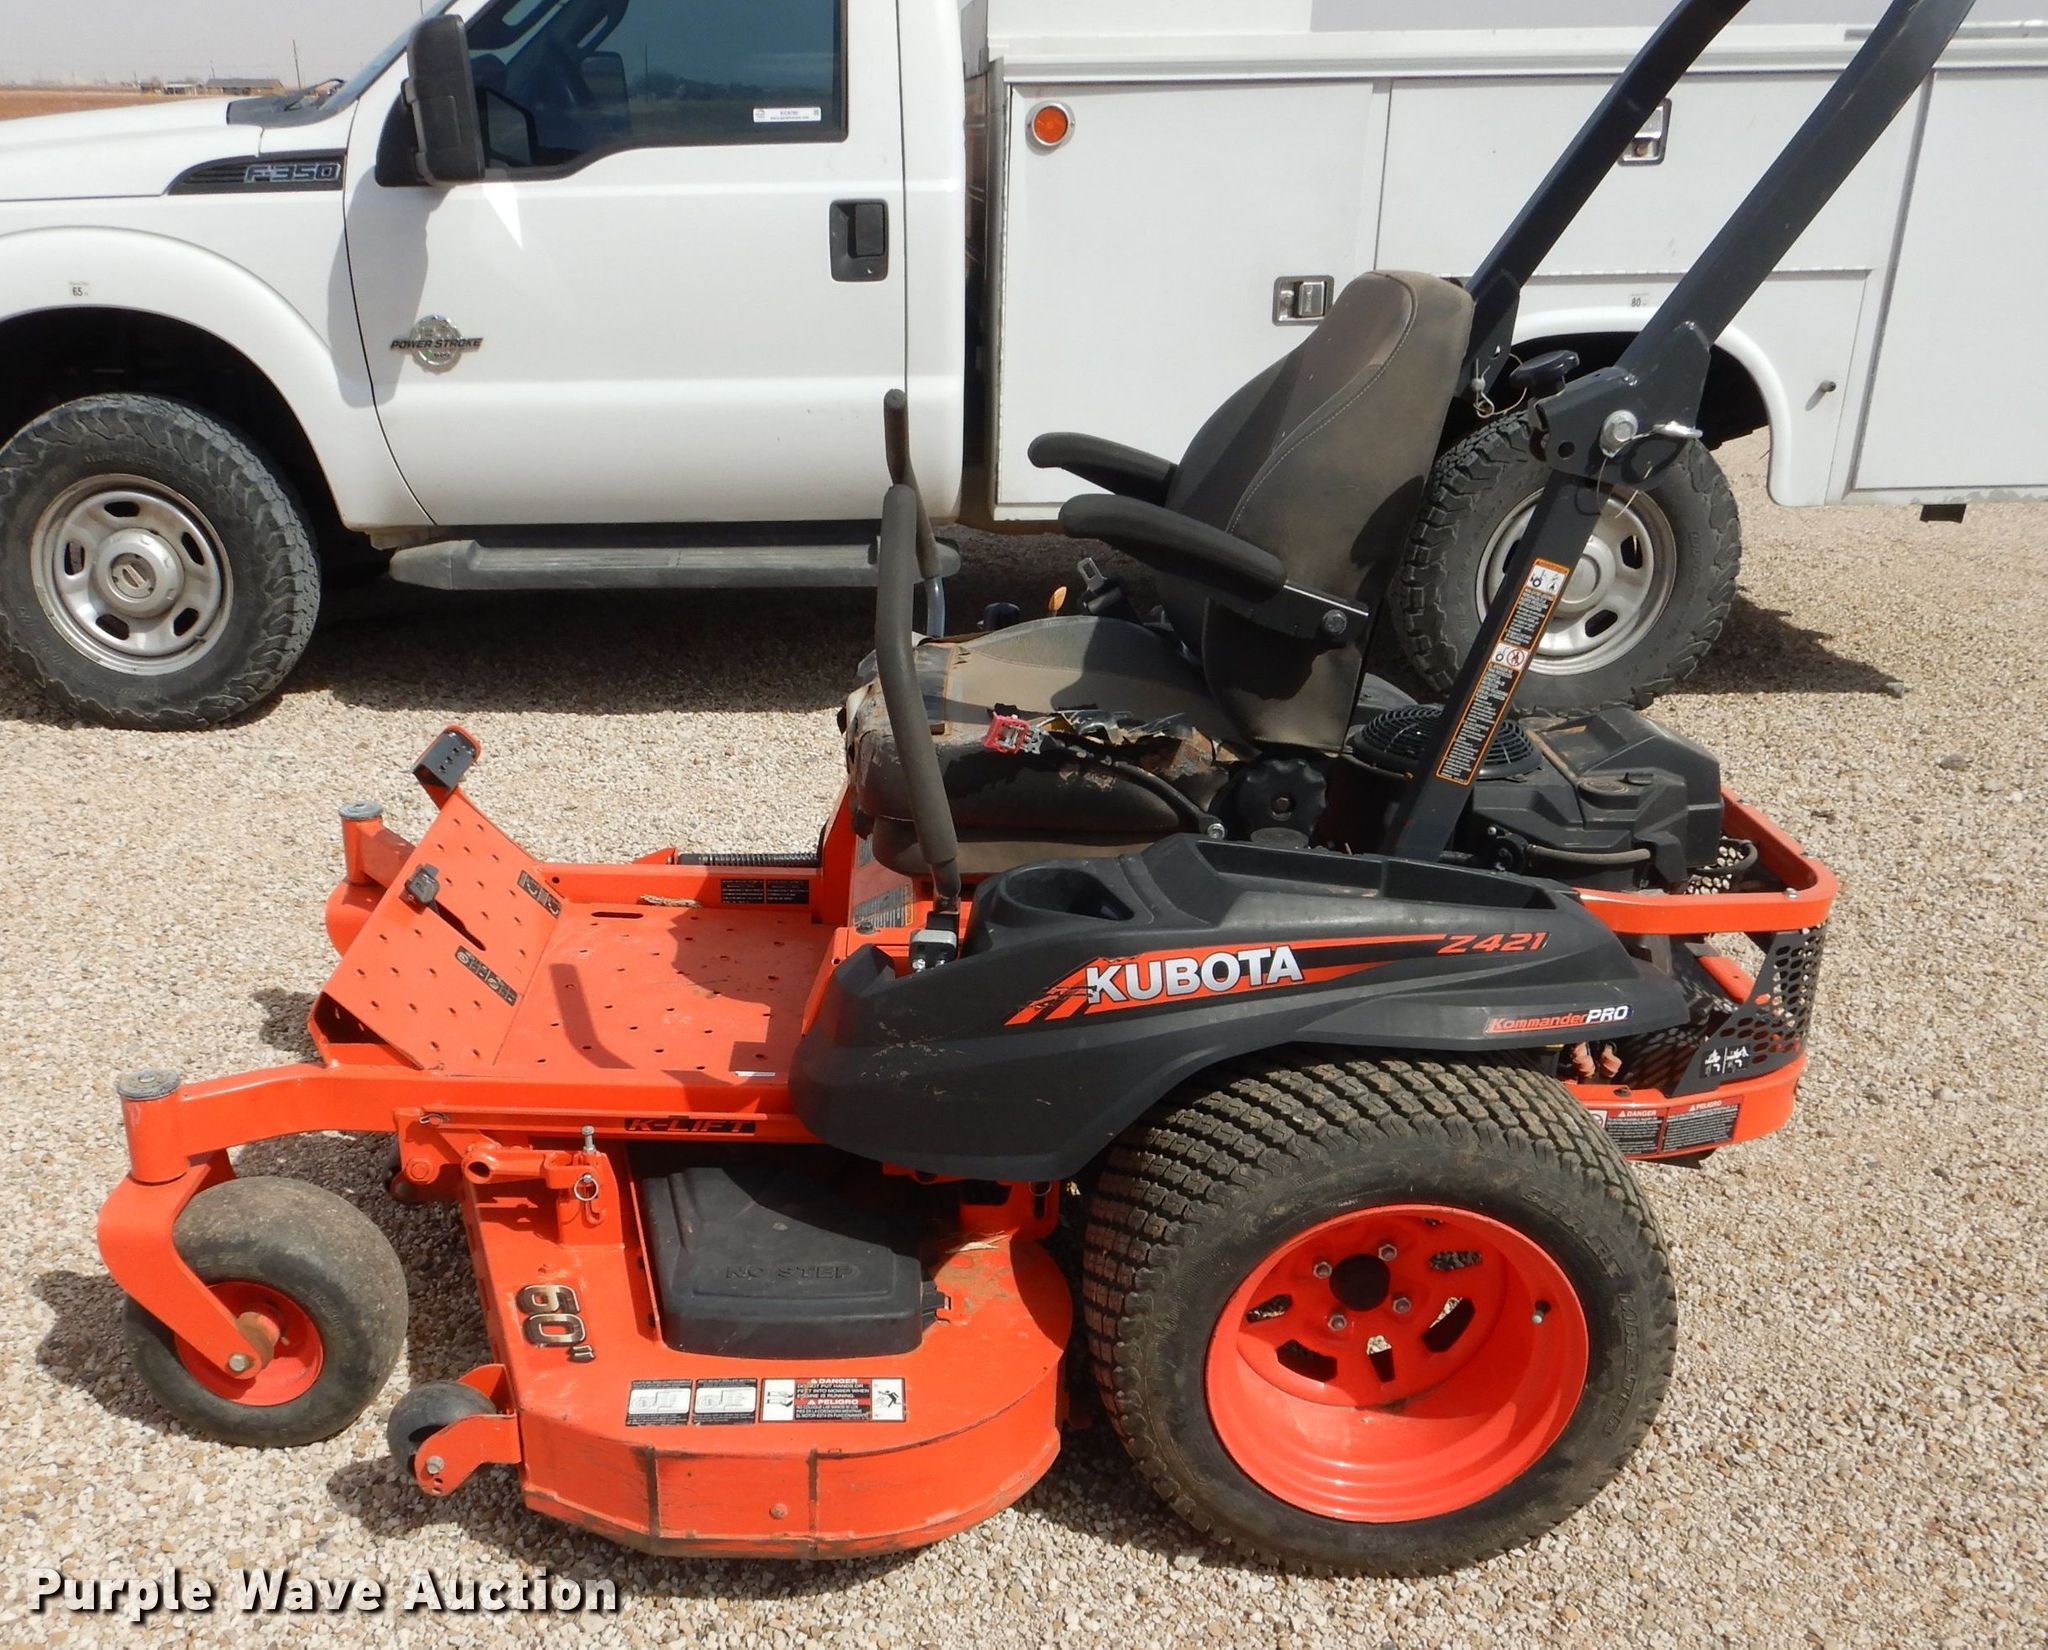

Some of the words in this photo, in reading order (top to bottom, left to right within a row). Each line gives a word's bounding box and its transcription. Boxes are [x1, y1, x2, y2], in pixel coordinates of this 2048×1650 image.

[390, 339, 433, 350] POWER
[434, 338, 481, 349] STROKE
[1437, 932, 1547, 954] Z421
[1086, 945, 1304, 1004] KUBOTA
[628, 1119, 748, 1133] K-LIFT
[725, 1264, 764, 1279] NO
[777, 1263, 855, 1280] STEP
